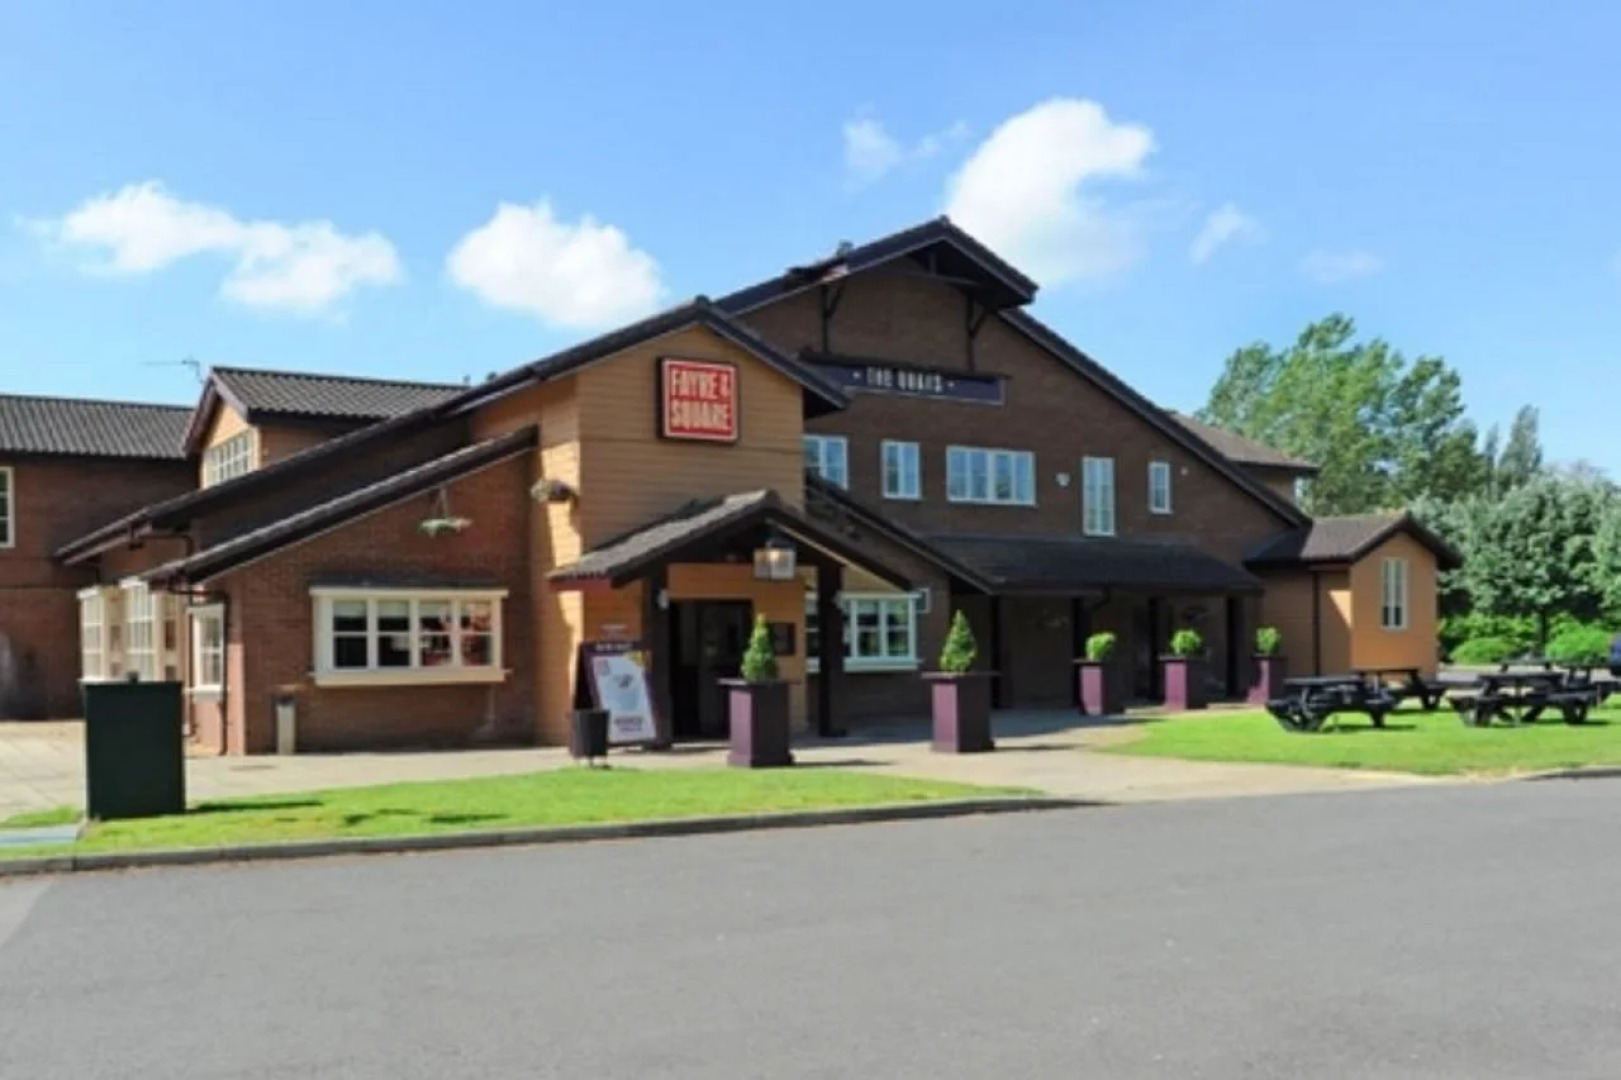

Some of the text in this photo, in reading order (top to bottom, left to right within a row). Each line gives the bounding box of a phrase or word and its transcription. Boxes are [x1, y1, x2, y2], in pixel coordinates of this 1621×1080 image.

[671, 369, 718, 399] FAYRE
[867, 367, 893, 387] THE
[671, 401, 731, 430] SQUARE
